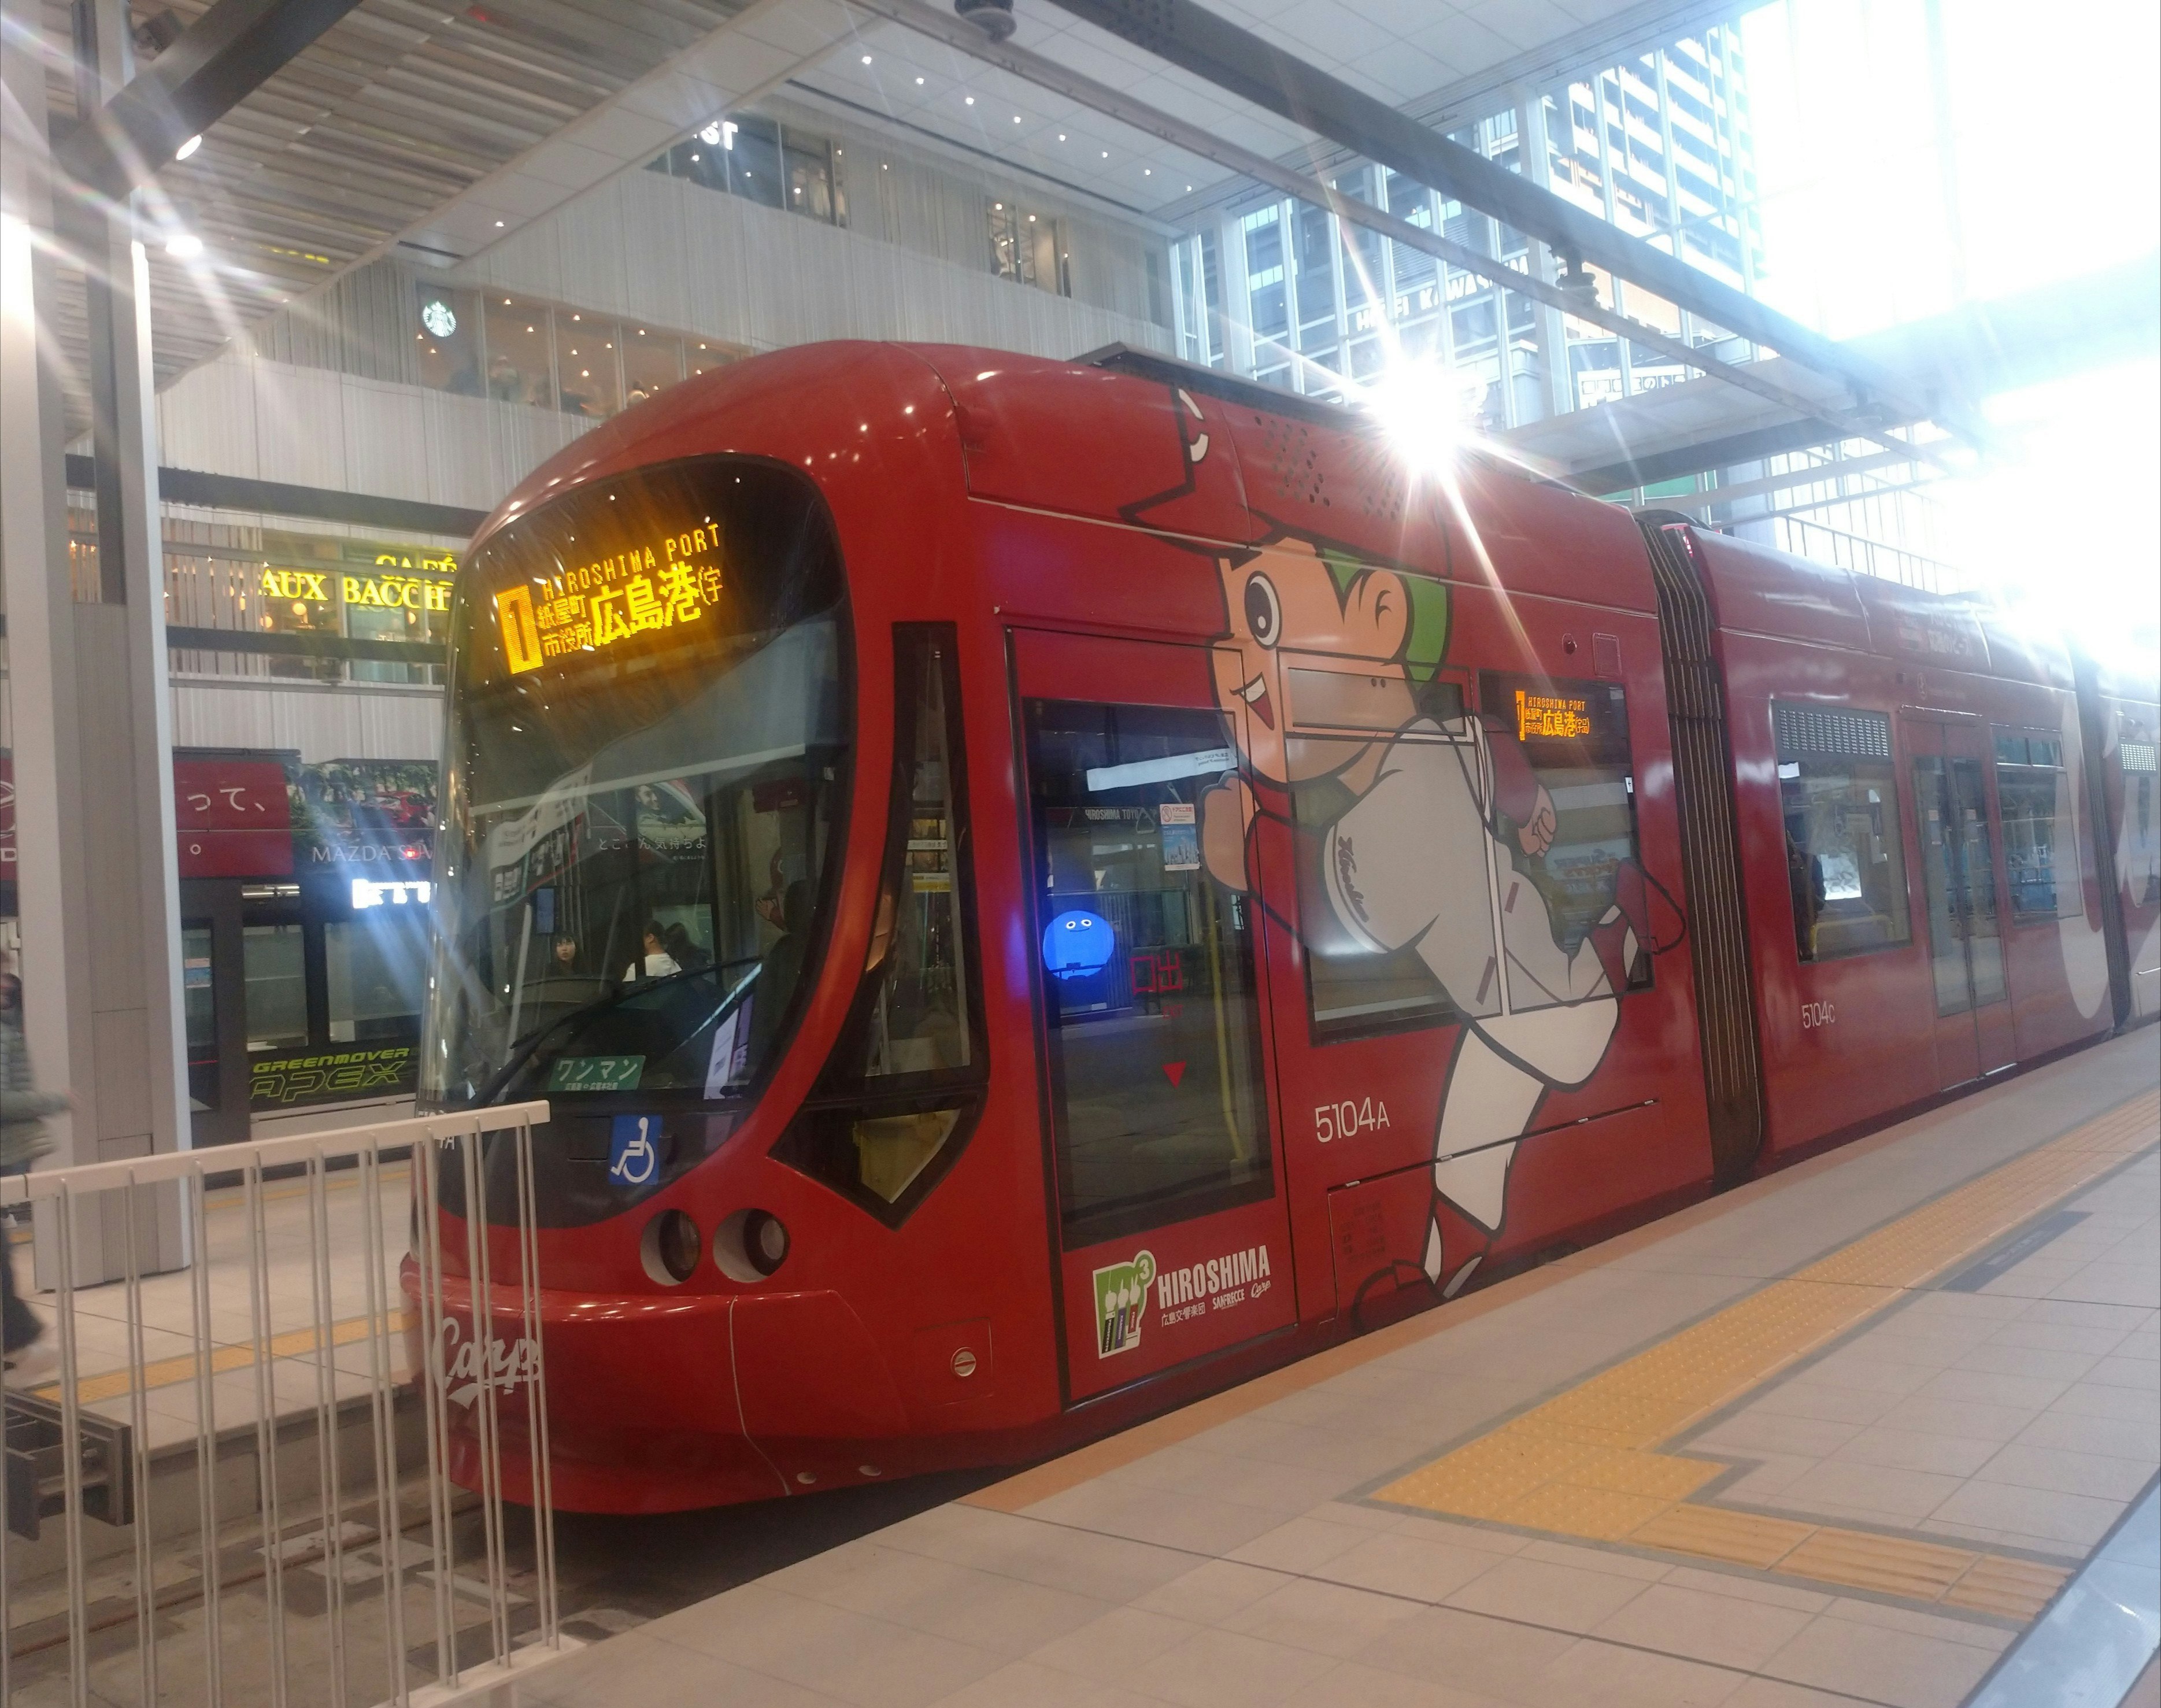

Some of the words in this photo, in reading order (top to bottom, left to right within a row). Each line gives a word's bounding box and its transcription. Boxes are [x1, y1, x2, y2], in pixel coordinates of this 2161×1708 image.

[541, 546, 656, 601] HIROSHIMA
[665, 523, 719, 562] PORT
[258, 568, 328, 601] AUX
[535, 594, 587, 630] 紙屋町
[541, 621, 595, 657] 市役所
[1568, 700, 1586, 711] PORT
[312, 845, 392, 863] MAZDA
[253, 1047, 410, 1074] GREENMOVER
[558, 1059, 638, 1081] ワンマン
[248, 1060, 406, 1103] APEX
[1315, 1096, 1390, 1143] 5104A
[1157, 1245, 1271, 1310] HIROSHIMA
[1212, 1289, 1245, 1310] SANFRECCE
[431, 1316, 542, 1410] Carp
